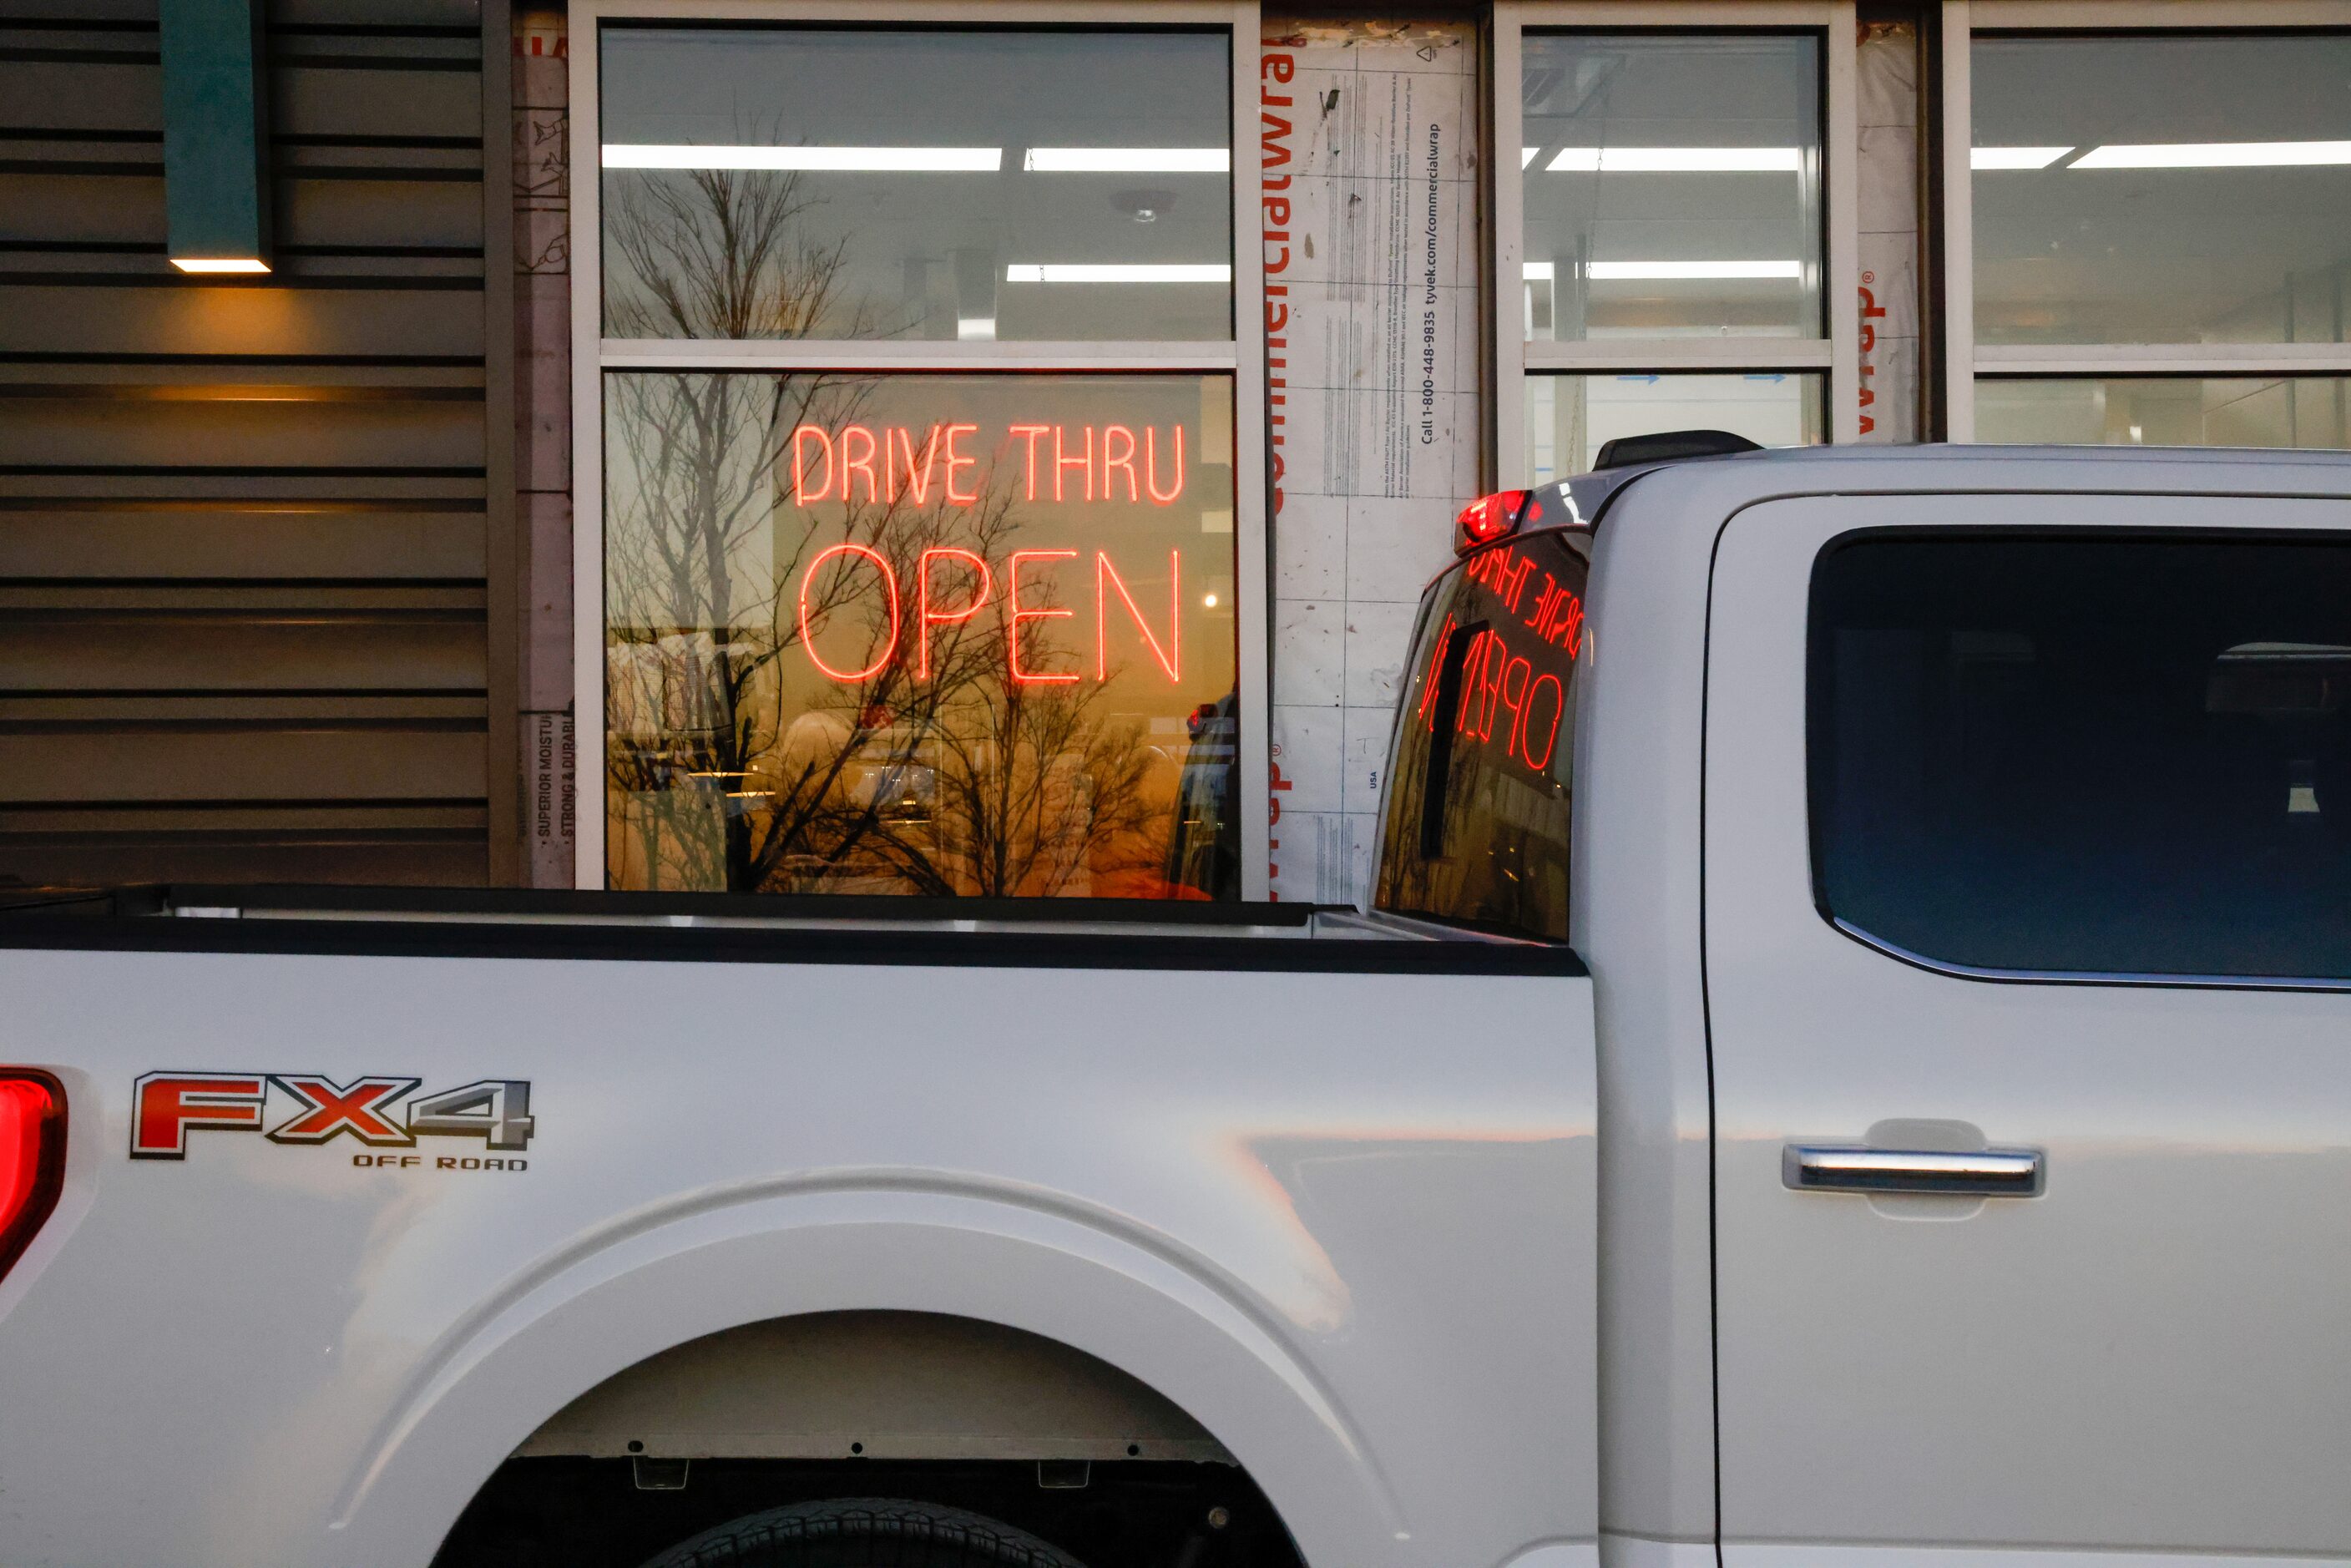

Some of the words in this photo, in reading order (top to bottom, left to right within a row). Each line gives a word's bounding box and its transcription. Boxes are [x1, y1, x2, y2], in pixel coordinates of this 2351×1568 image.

[1424, 124, 1440, 305] tyvek.com/commercialwrap
[1422, 311, 1435, 416] 1-800-448-9835
[793, 423, 978, 506] DRIVE
[1008, 423, 1186, 503] THRU
[1421, 420, 1433, 445] Call
[799, 544, 1181, 682] OPEN
[538, 773, 551, 837] SUPERIOR
[562, 772, 574, 781] &
[1369, 771, 1378, 789] USA
[561, 784, 574, 837] STRONG
[129, 1070, 535, 1161] FX4
[352, 1154, 421, 1169] OFF
[436, 1156, 528, 1171] ROAD
